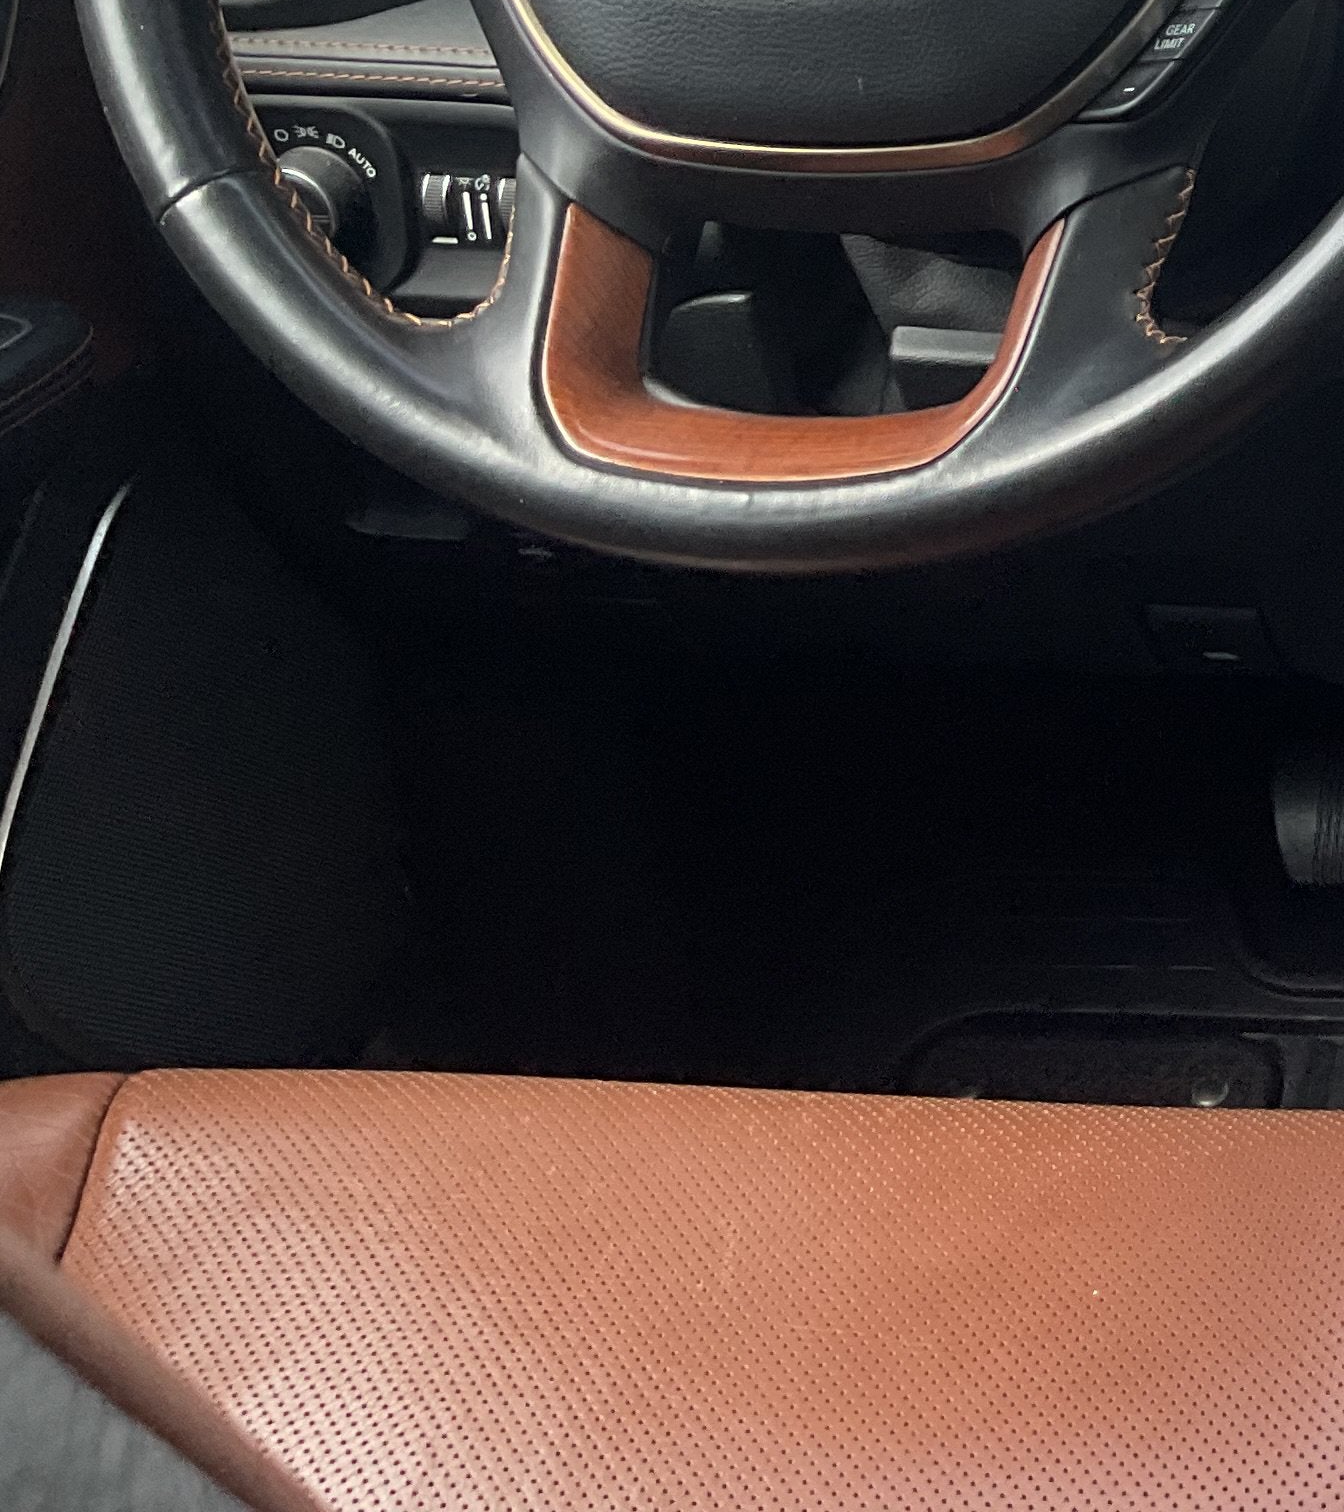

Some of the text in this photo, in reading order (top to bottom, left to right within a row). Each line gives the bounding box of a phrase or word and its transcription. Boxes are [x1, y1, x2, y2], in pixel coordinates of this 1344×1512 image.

[1166, 23, 1196, 36] GEAR
[1154, 37, 1185, 50] LIMIT
[348, 147, 377, 179] AUTO
